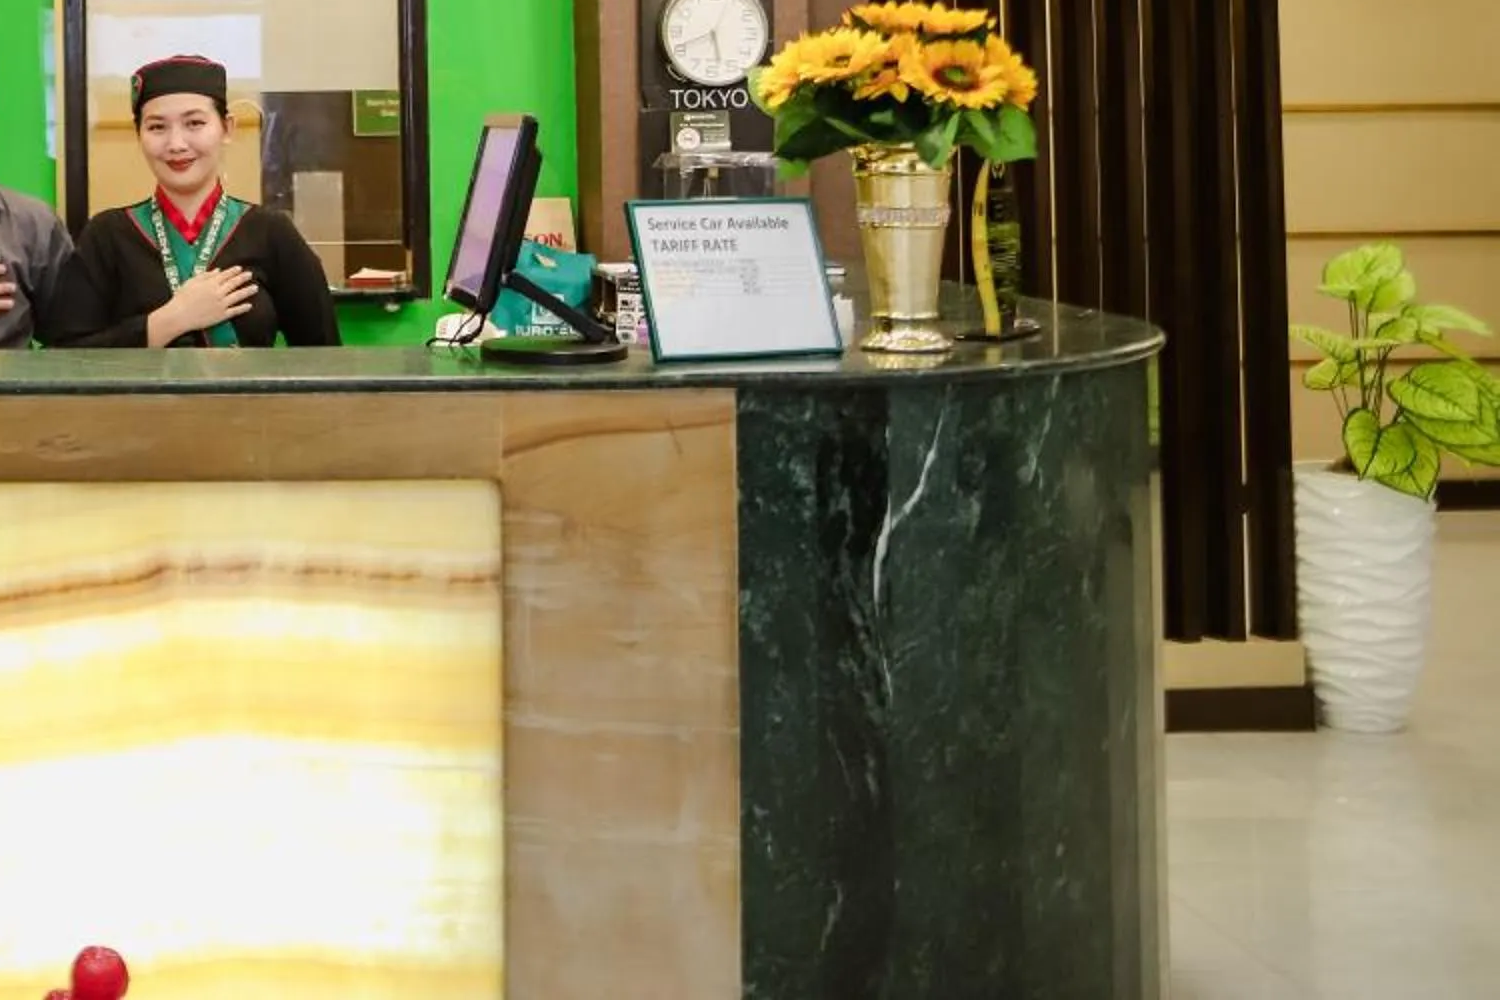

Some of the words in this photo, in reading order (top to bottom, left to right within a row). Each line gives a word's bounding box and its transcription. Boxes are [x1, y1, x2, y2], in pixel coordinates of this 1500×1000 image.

[669, 88, 749, 109] TOKYO
[648, 217, 696, 231] Service
[700, 217, 723, 230] Car
[727, 216, 789, 230] Available
[652, 239, 699, 253] TARIFF
[702, 239, 738, 253] RATE
